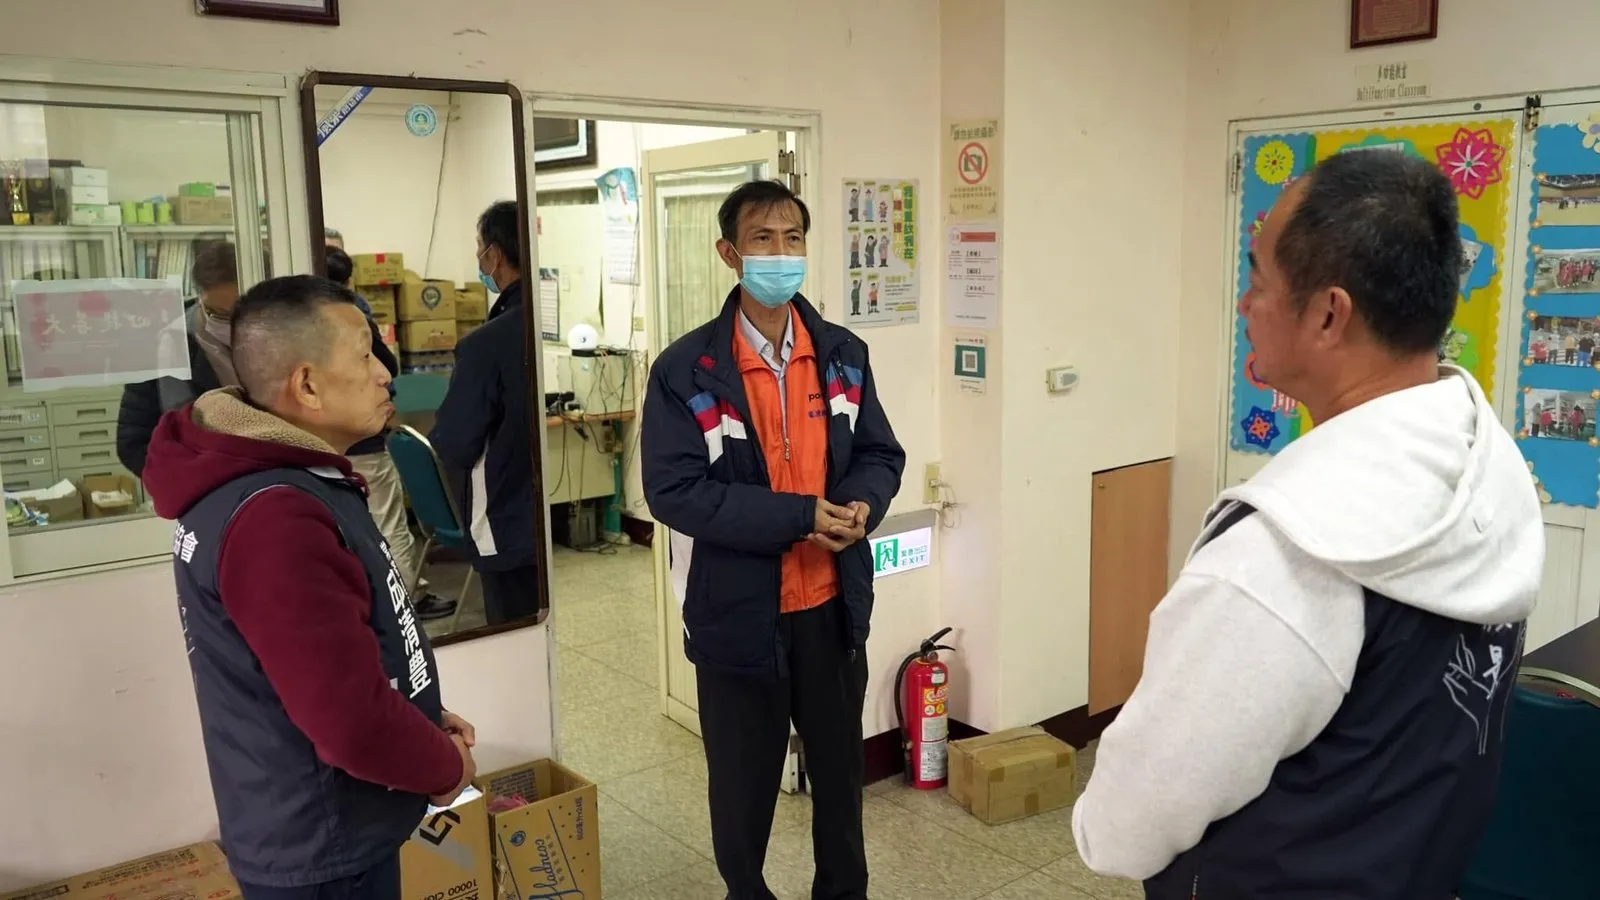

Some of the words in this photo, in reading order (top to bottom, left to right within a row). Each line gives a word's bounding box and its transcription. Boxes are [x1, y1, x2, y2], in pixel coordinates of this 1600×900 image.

[1377, 63, 1407, 82] 多功能教室
[1356, 85, 1395, 101] Multifunction
[1397, 84, 1427, 97] Classroom
[901, 545, 927, 557] 緊急出口
[902, 554, 925, 566] EXIT
[448, 878, 478, 896] 10000
